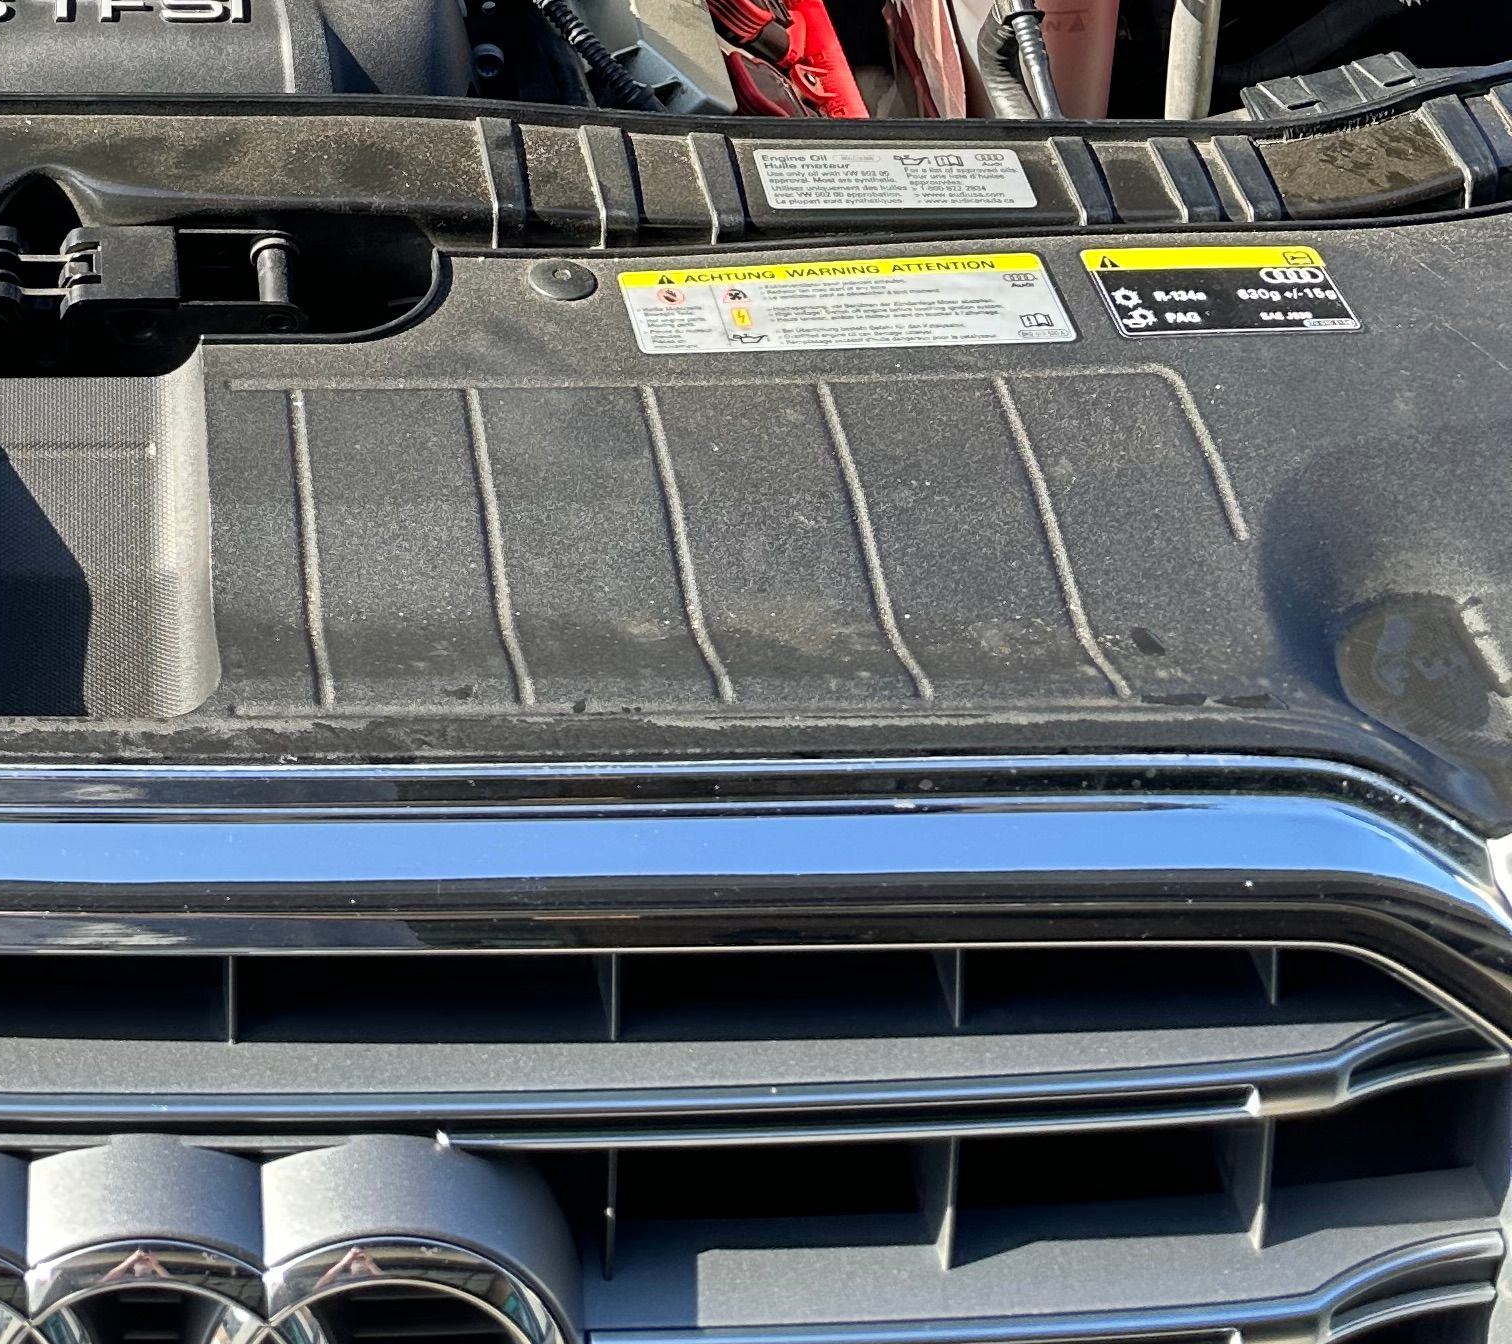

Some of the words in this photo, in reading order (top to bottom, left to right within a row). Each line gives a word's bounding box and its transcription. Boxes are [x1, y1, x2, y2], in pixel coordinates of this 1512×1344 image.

[761, 154, 806, 163] Engine
[810, 154, 828, 162] Oil
[684, 270, 775, 283] ACHTUNG
[785, 264, 880, 278] WARNING
[891, 260, 996, 273] ATTENTION
[1164, 311, 1201, 324] PAG
